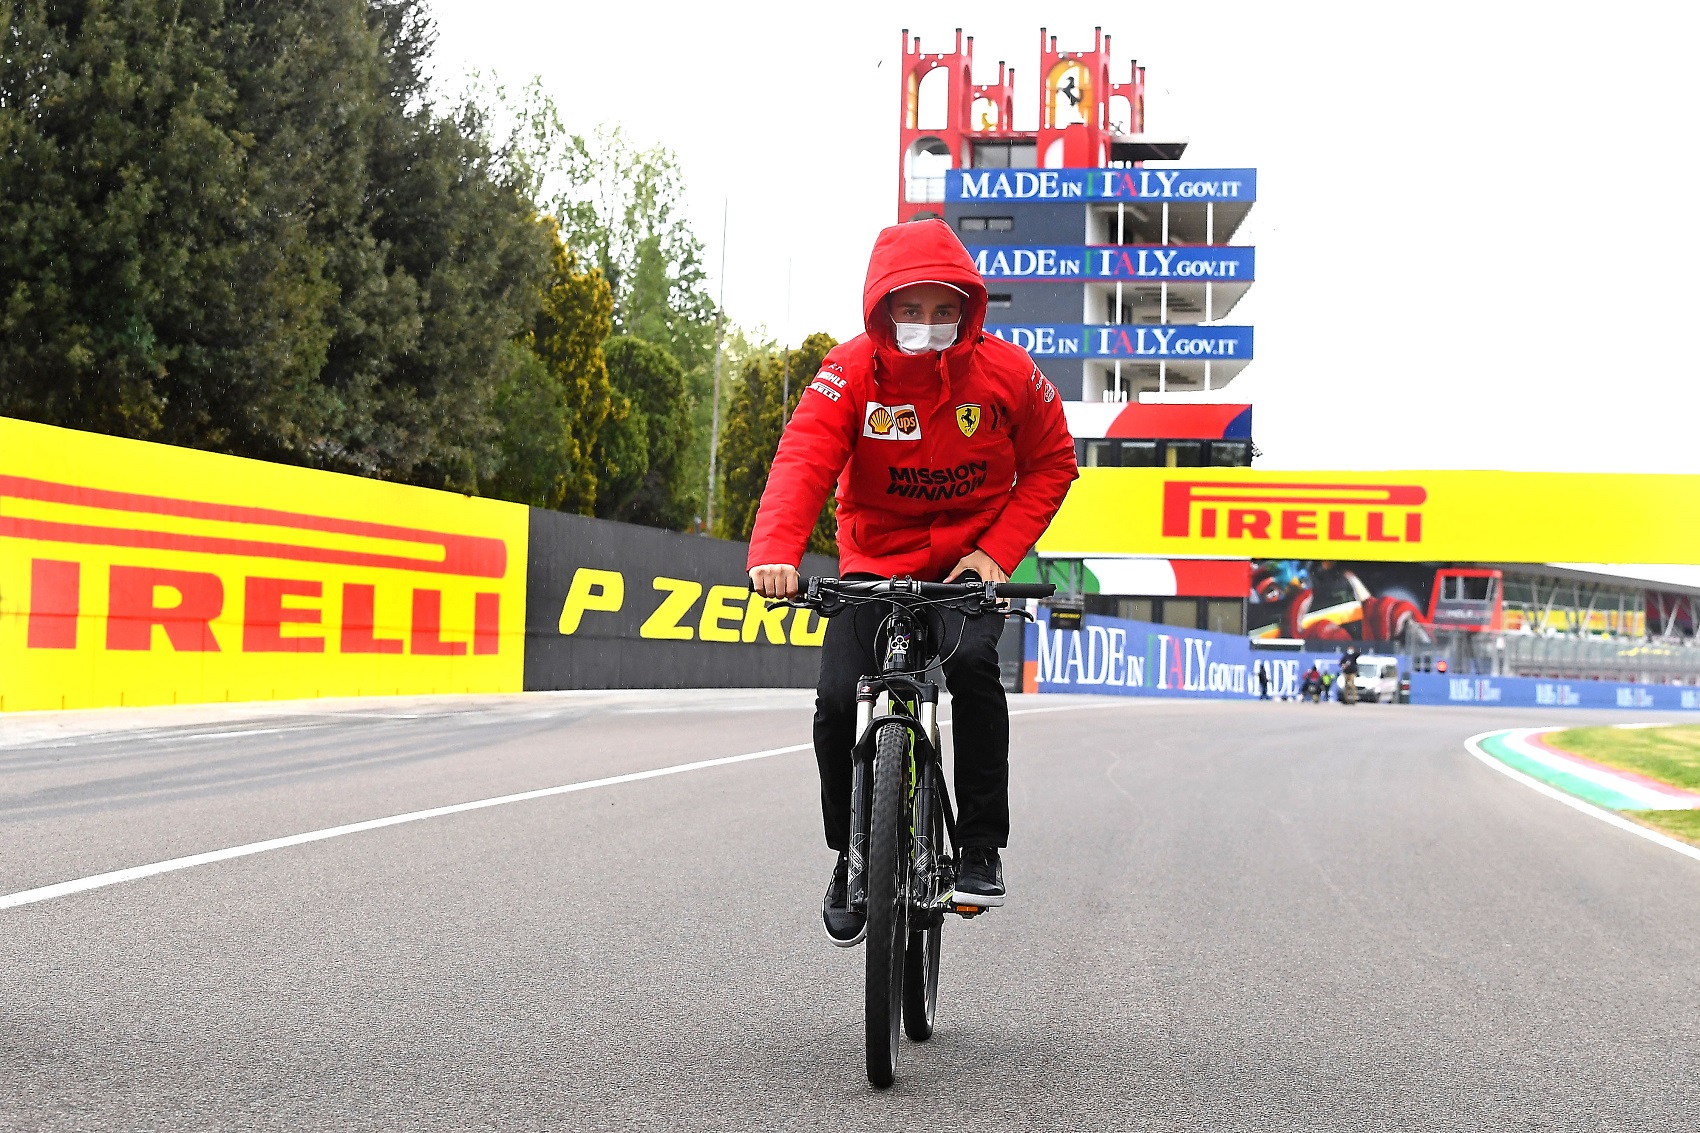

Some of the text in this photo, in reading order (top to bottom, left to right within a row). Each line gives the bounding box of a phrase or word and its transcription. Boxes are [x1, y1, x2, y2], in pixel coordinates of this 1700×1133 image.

[960, 171, 1060, 200] MADE
[1062, 182, 1083, 198] IN
[1060, 260, 1081, 275] IN
[993, 327, 1056, 355] DE
[1059, 337, 1080, 353] IN
[888, 460, 987, 485] MISSION
[886, 473, 987, 502] WINNOW
[1162, 480, 1427, 543] PIRELLI
[558, 567, 625, 636] P
[1035, 619, 1127, 687] MADE
[1126, 655, 1145, 687] IN
